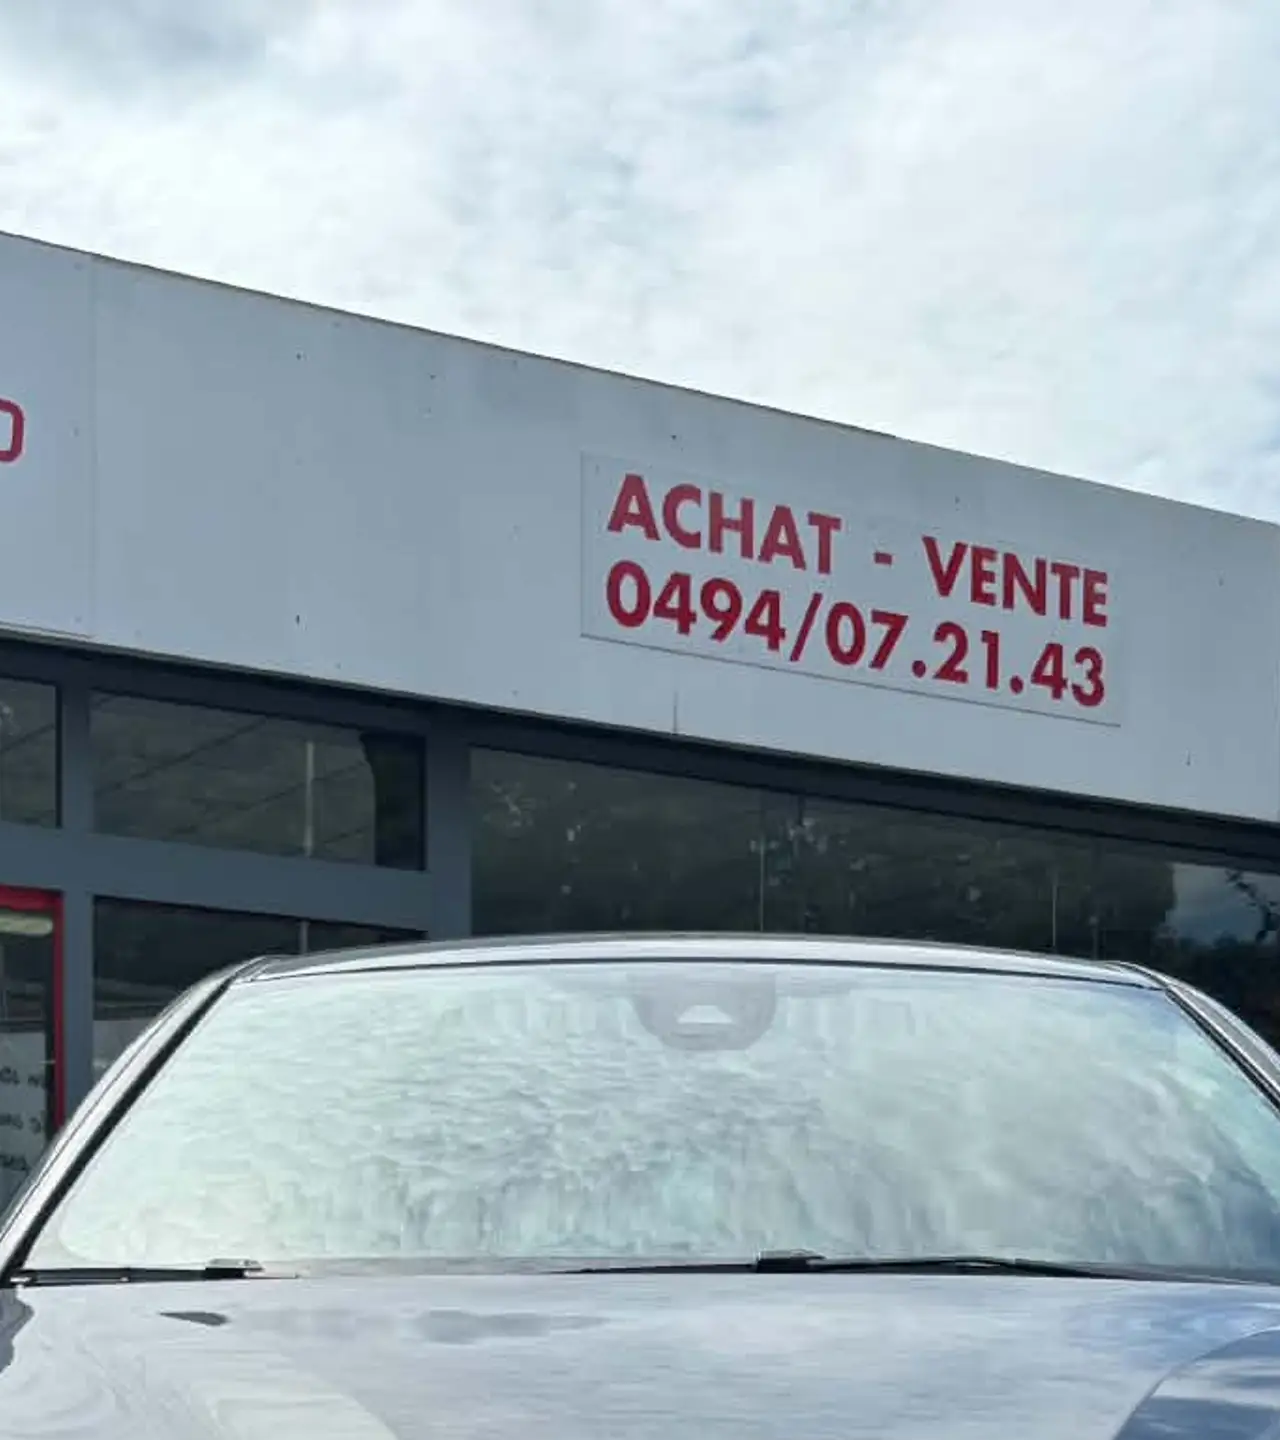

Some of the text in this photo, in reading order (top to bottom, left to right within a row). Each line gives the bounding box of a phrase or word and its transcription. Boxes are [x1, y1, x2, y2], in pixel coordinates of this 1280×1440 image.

[607, 473, 842, 575] ACHAT
[922, 535, 1109, 627] VENTE
[606, 560, 1106, 707] 0494/07.21.43
